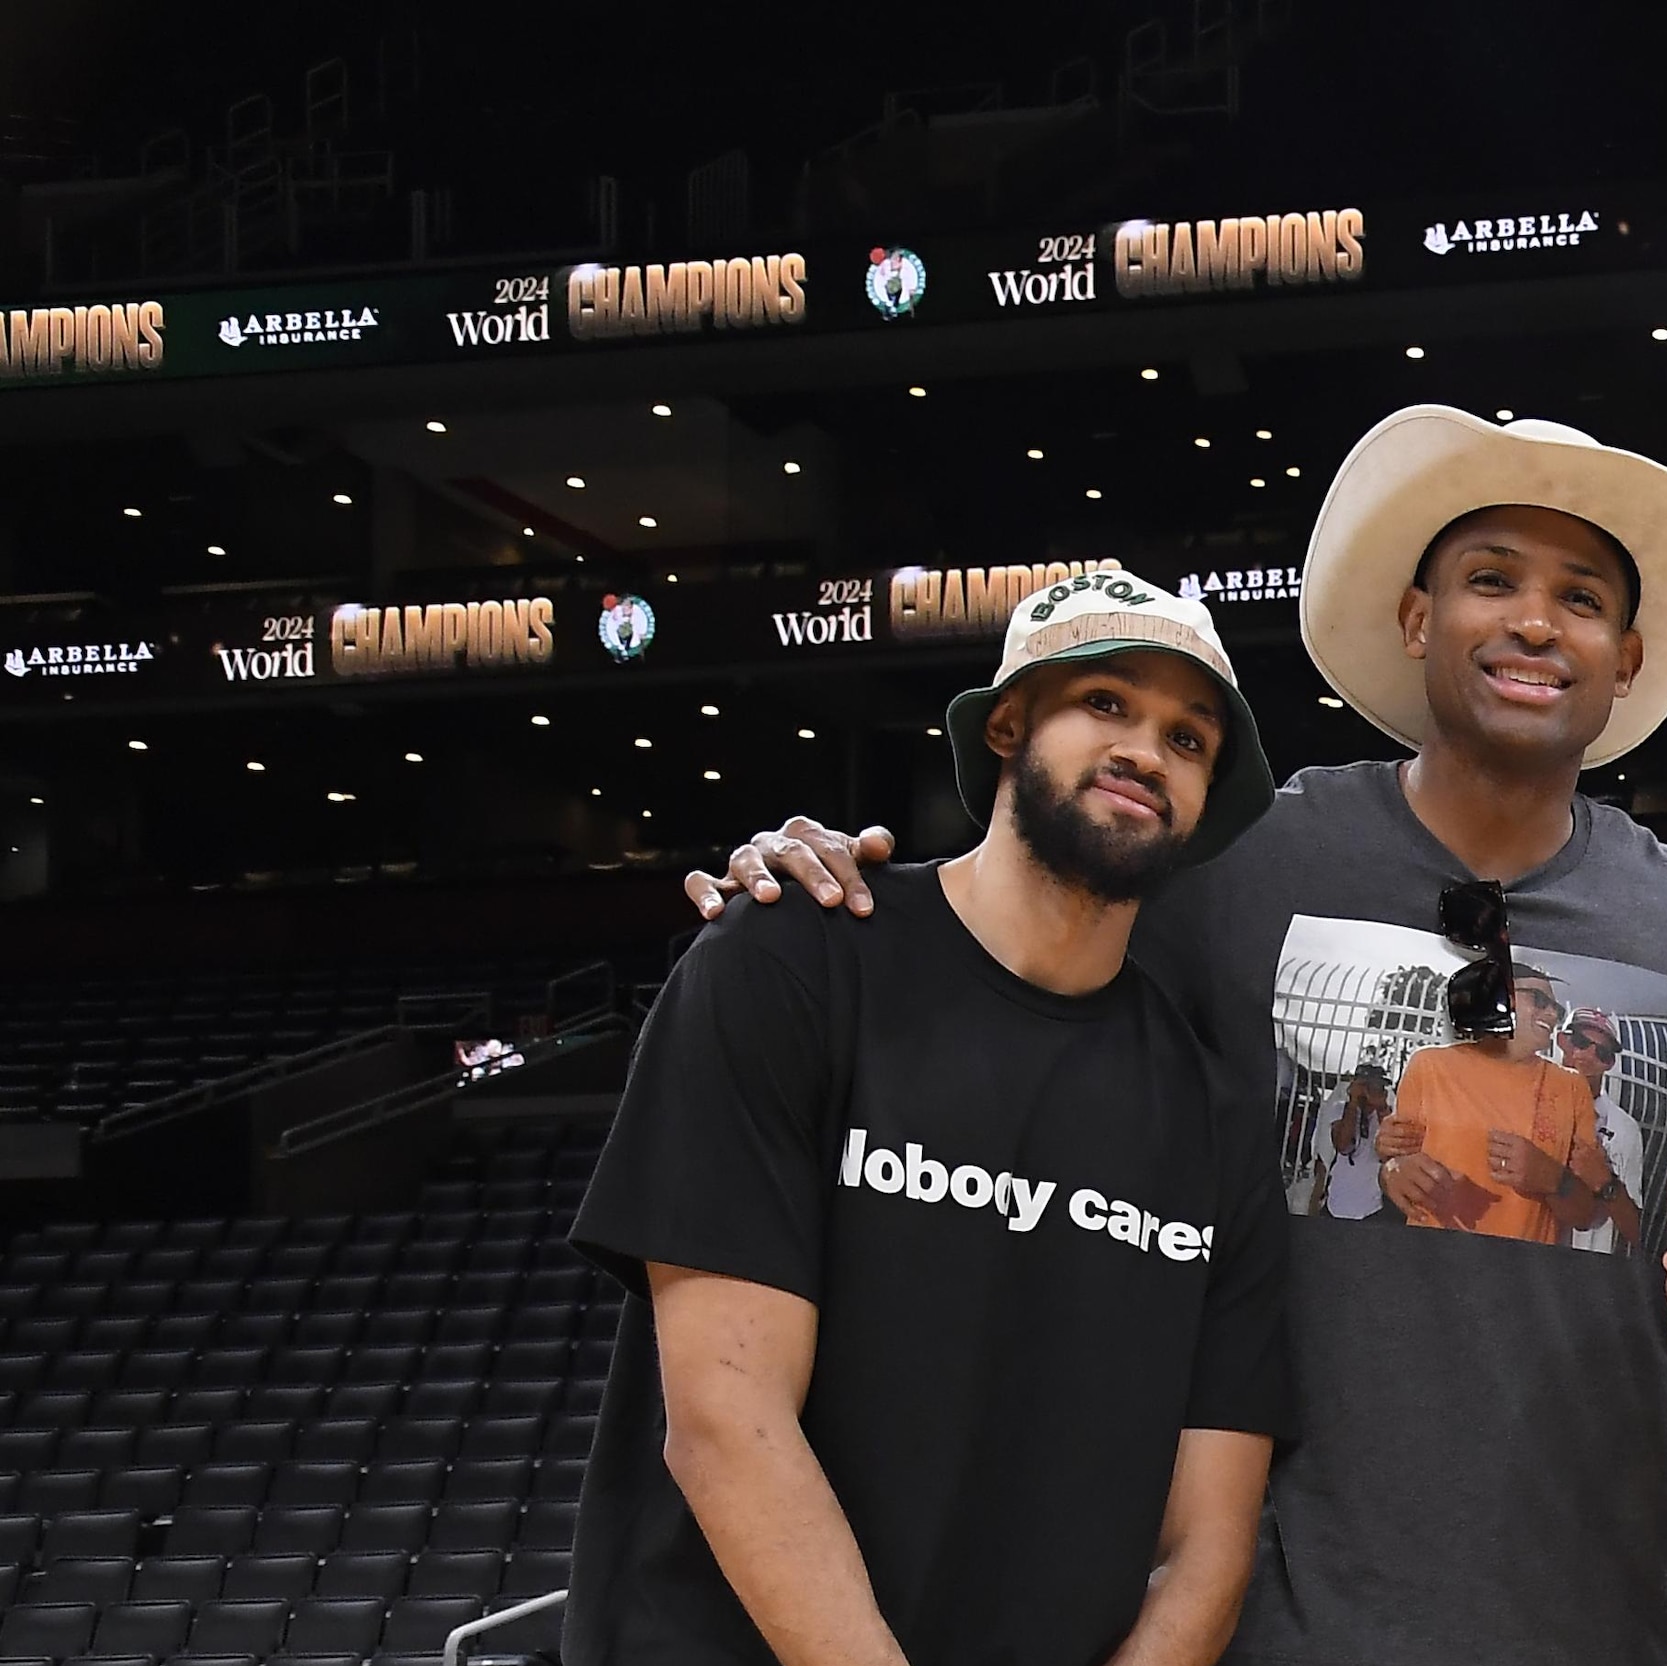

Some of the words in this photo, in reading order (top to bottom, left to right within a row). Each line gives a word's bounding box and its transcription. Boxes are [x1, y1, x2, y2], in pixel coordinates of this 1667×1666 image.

[1450, 211, 1597, 242] ARBELLA
[1039, 235, 1096, 262] 2024
[1114, 209, 1366, 299] CHAMPIONS
[1468, 233, 1581, 254] INSURANCE
[494, 276, 549, 303] 2024
[566, 253, 806, 341] CHAMPIONS
[990, 265, 1096, 306] World
[243, 306, 376, 336] ARBELLA
[448, 306, 549, 346] World
[259, 328, 361, 345] INSURANCE
[819, 580, 873, 607] 2024
[1203, 570, 1302, 592] ARBEL
[1219, 586, 1299, 602] INSURAN
[889, 560, 1123, 640] CHAMP
[1029, 571, 1156, 623] BOSTON
[262, 616, 314, 641] 2024
[329, 597, 555, 677] CHAMPIONS
[773, 608, 873, 646] World
[27, 641, 153, 667] ARBELLA
[42, 661, 139, 676] INSURANCE
[218, 643, 314, 681] World
